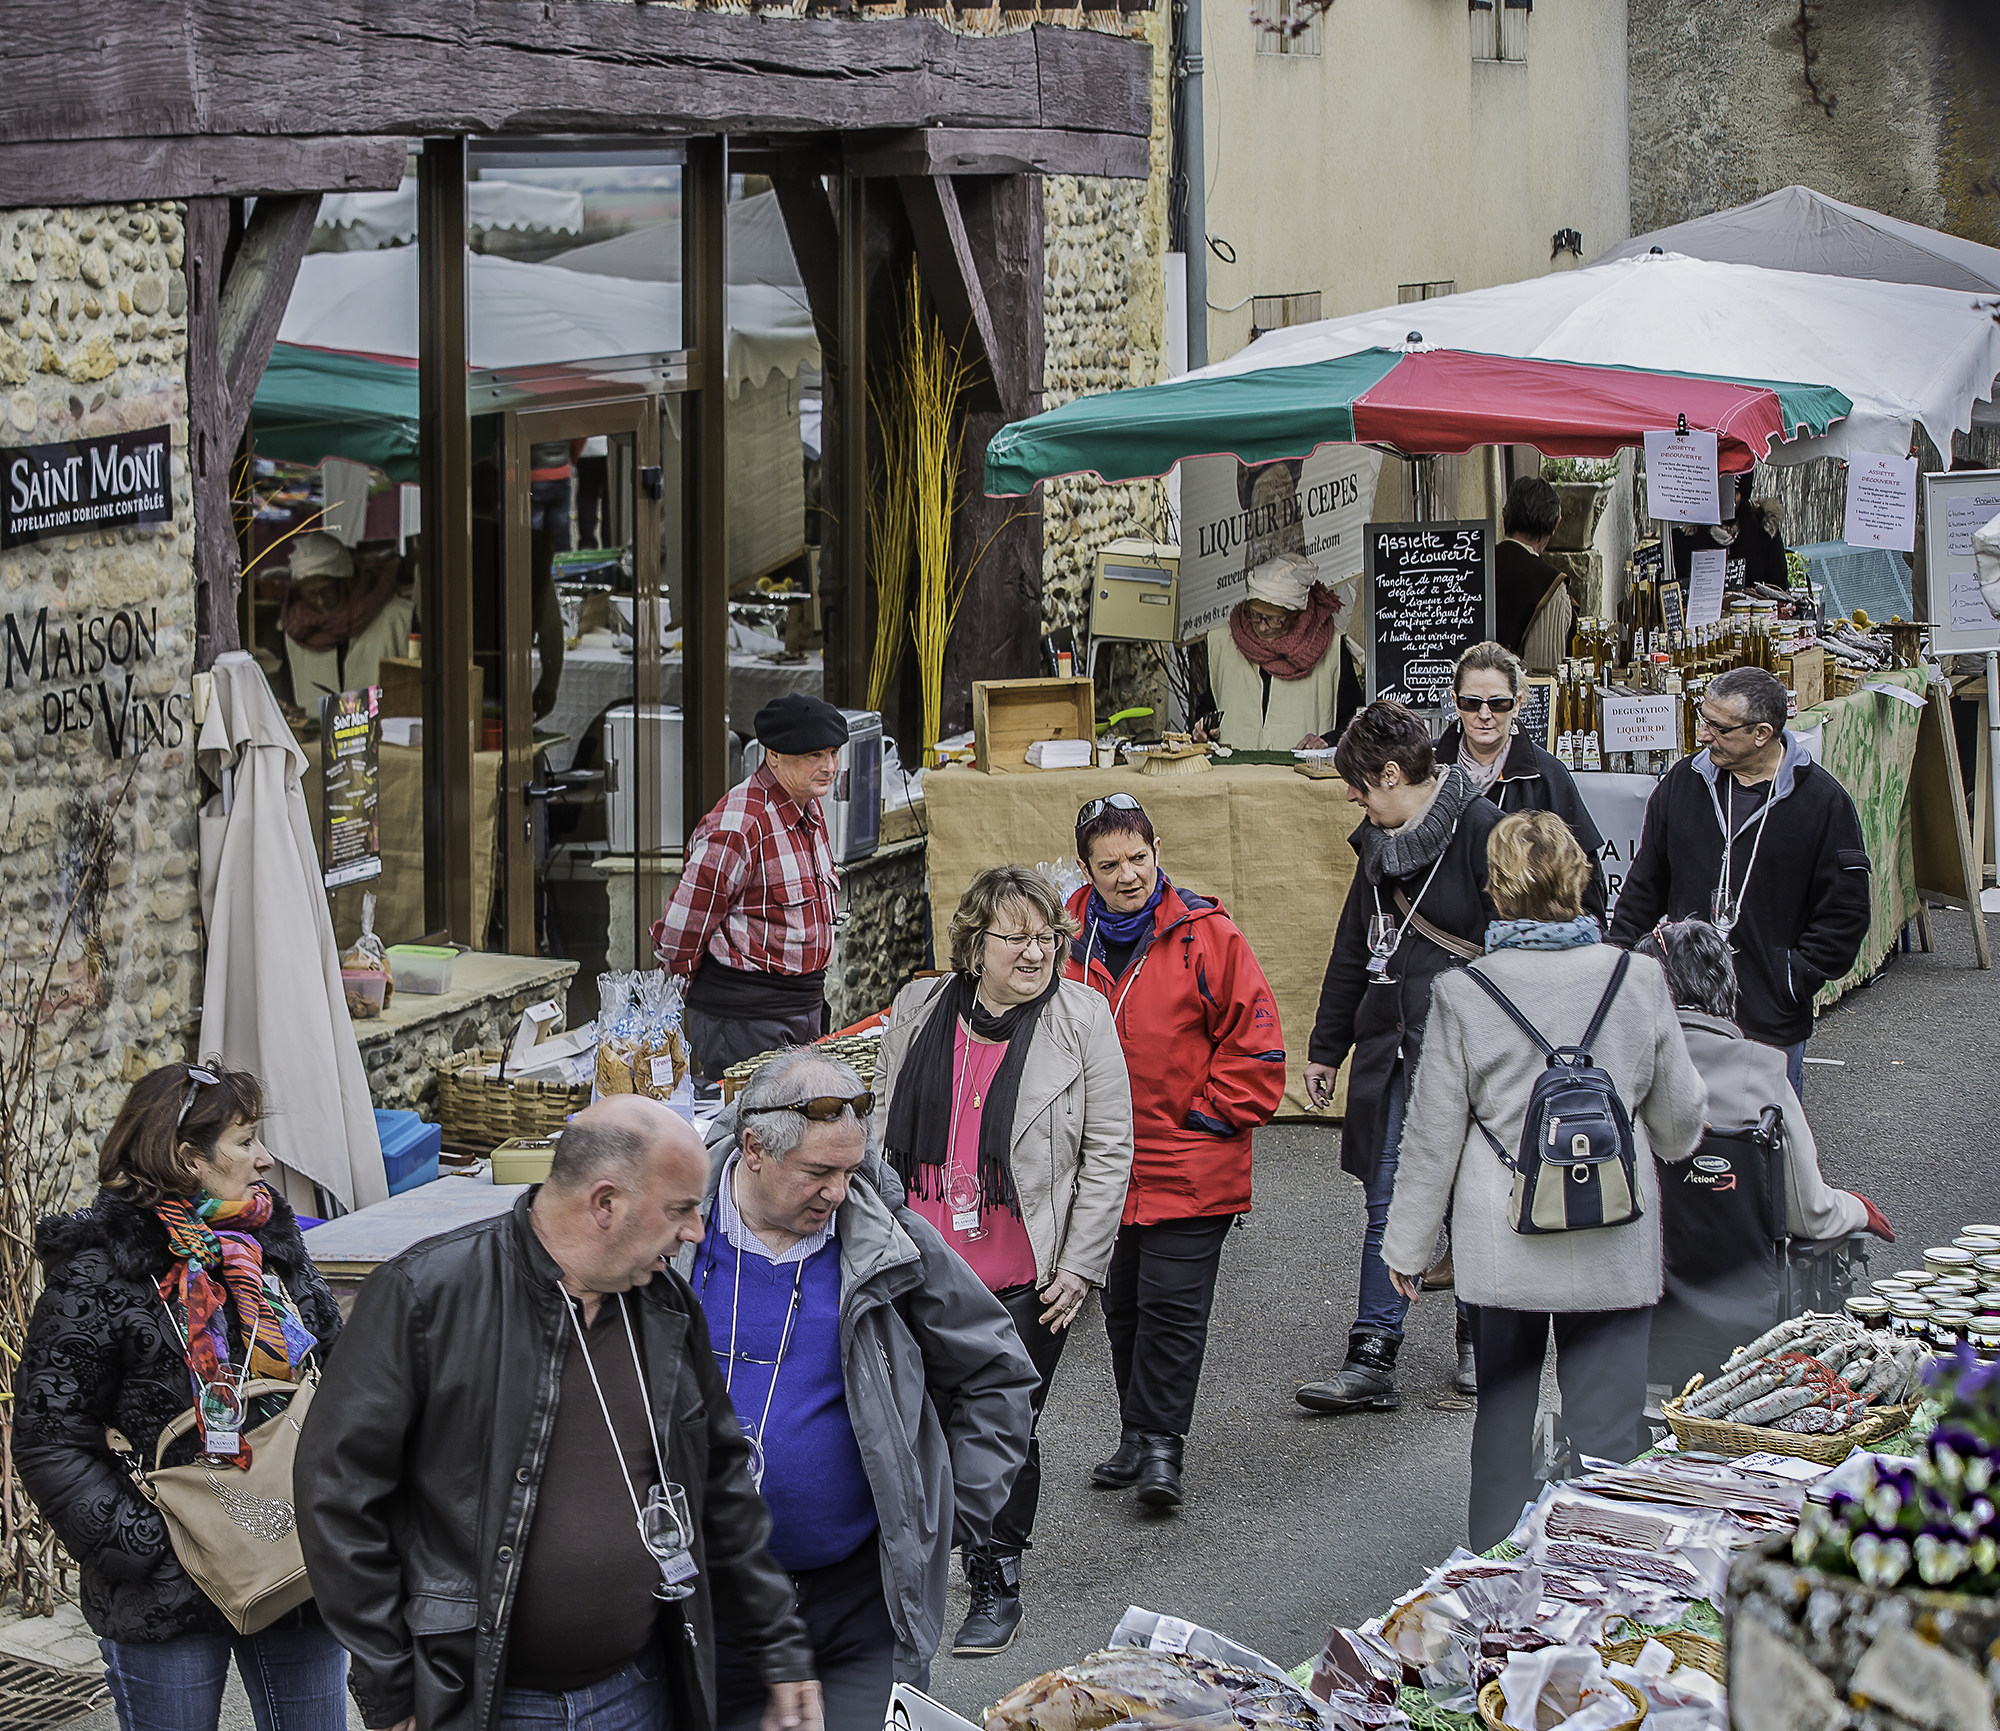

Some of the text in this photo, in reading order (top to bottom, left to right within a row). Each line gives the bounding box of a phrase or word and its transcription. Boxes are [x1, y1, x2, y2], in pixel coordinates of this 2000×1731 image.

[90, 442, 164, 499] MONT
[11, 511, 71, 533] APPELLATION
[115, 492, 165, 516] CONTRÔLÉE
[1198, 473, 1358, 559] LIQUEUR DE CEPES
[1378, 531, 1445, 558] Assiette
[1414, 573, 1430, 586] de
[1431, 605, 1460, 618] chaud
[1463, 606, 1476, 617] et
[1414, 634, 1427, 642] au
[43, 684, 94, 735] DES
[1611, 706, 1670, 716] DEGUSTATION
[1616, 724, 1667, 734] LIQUEUR DE
[1628, 735, 1655, 743] CEPES
[1683, 1170, 1716, 1184] Action
